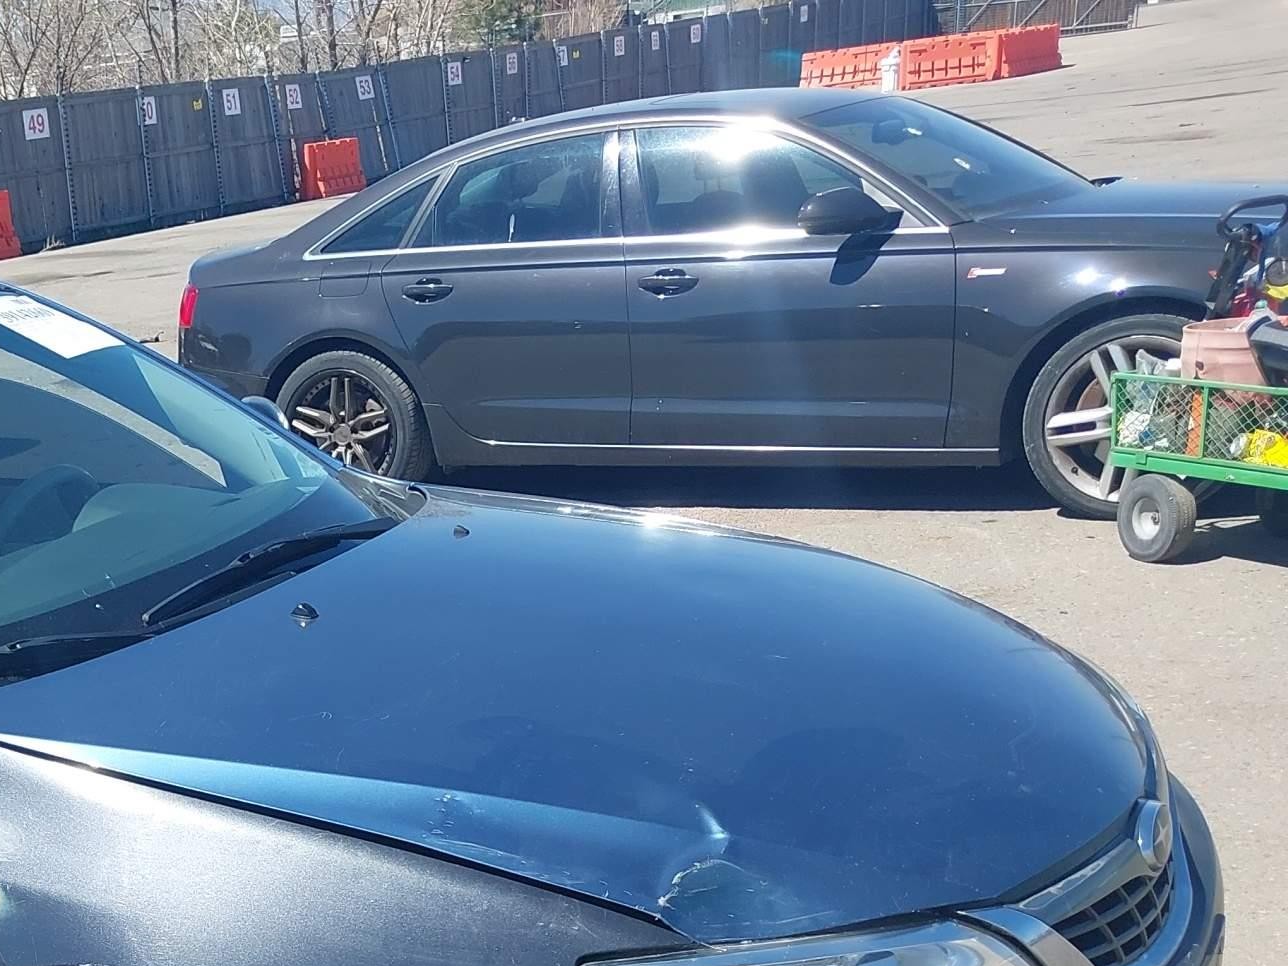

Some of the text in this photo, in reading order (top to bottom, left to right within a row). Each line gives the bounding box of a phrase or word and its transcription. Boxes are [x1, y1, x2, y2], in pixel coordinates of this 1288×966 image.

[450, 65, 460, 82] 54
[359, 79, 372, 96] 53
[225, 93, 238, 111] 51
[288, 88, 300, 105] 52
[28, 113, 45, 134] 49
